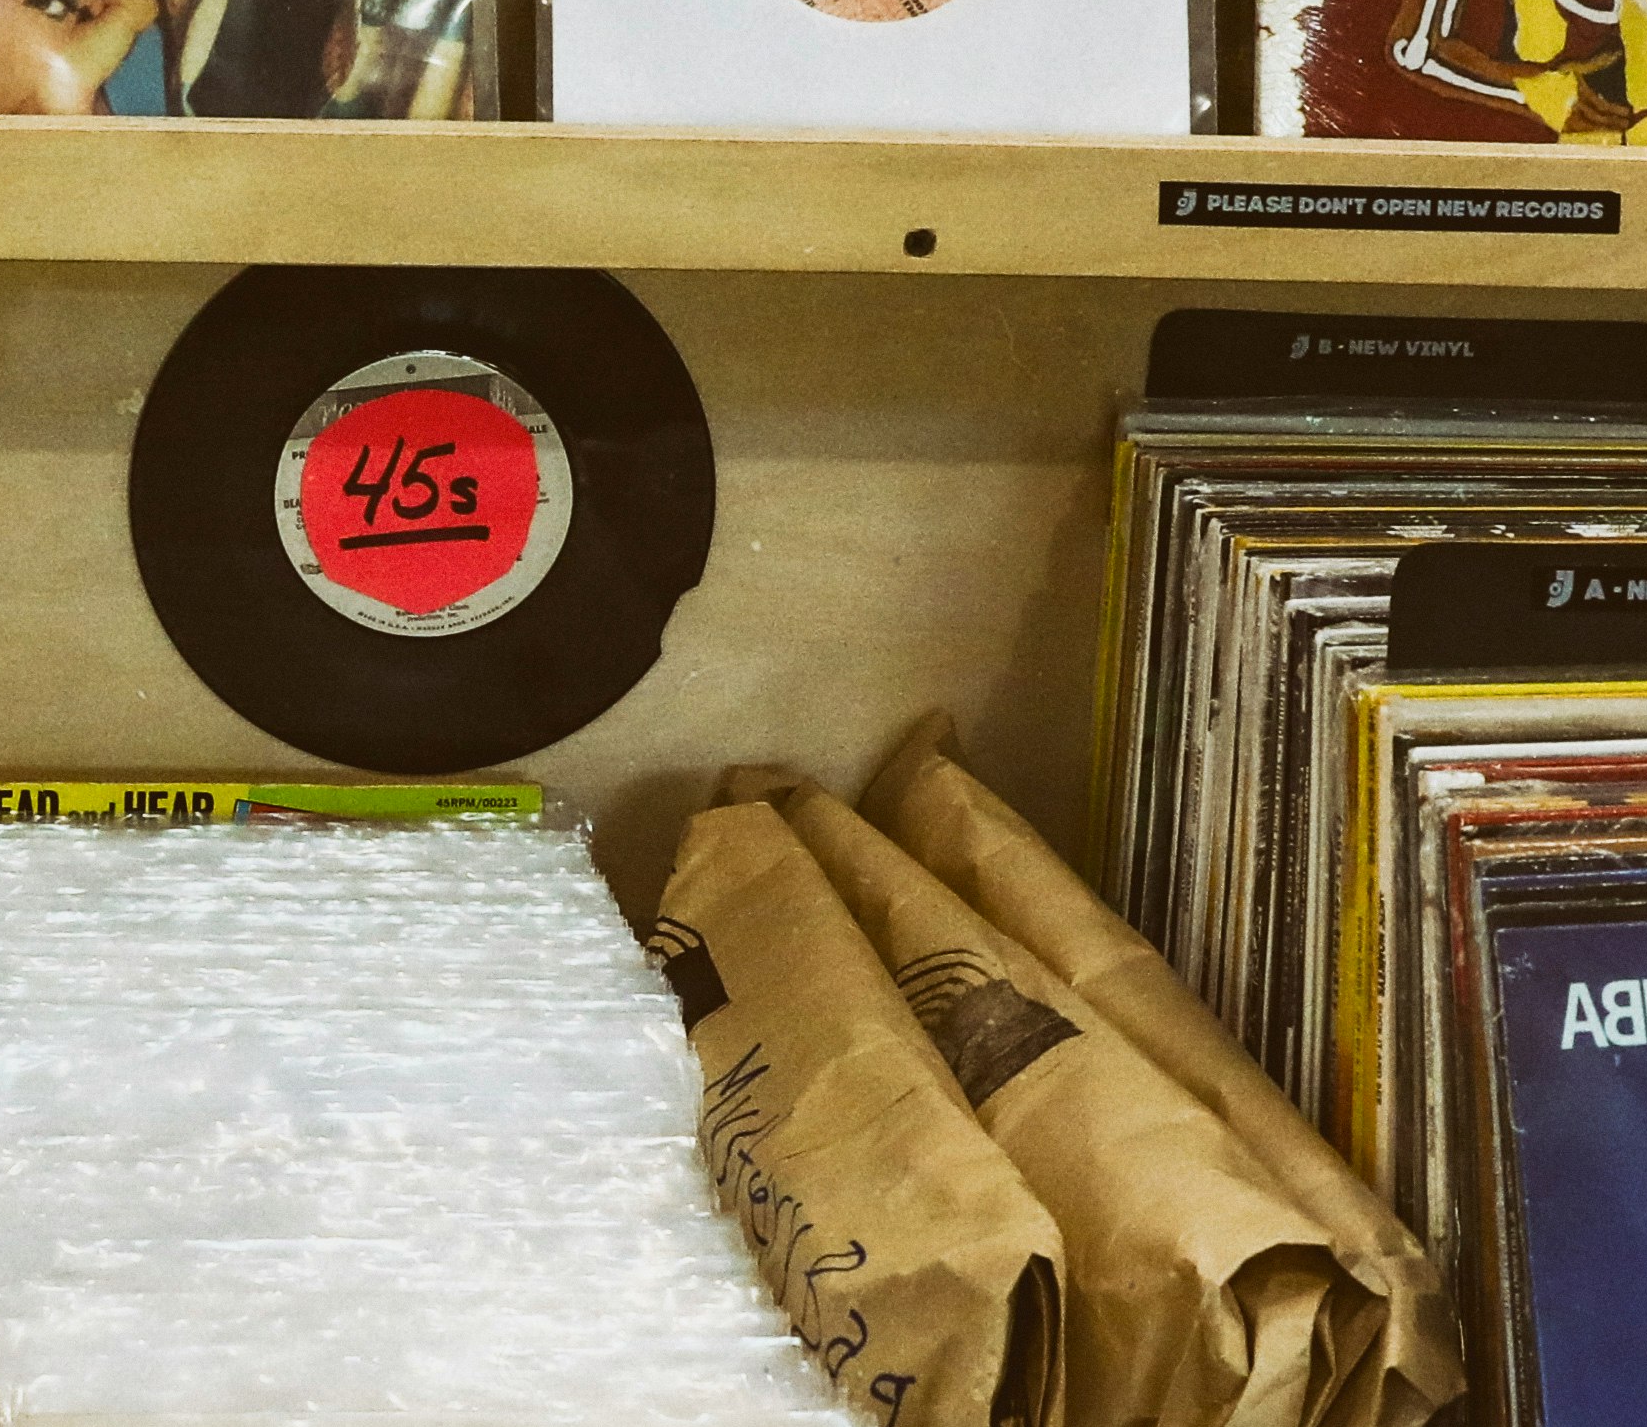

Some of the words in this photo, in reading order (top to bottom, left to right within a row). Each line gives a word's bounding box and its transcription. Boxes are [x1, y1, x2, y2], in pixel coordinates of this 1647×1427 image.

[1205, 192, 1293, 216] PLEASE
[1296, 193, 1366, 218] DON'T
[1371, 196, 1431, 219] OPEN
[1435, 198, 1490, 220] NEW
[1493, 198, 1605, 222] RECORDS
[1349, 338, 1400, 359] NEW
[1406, 338, 1475, 359] VINYL
[342, 436, 479, 526] 45s
[1583, 578, 1607, 602] A
